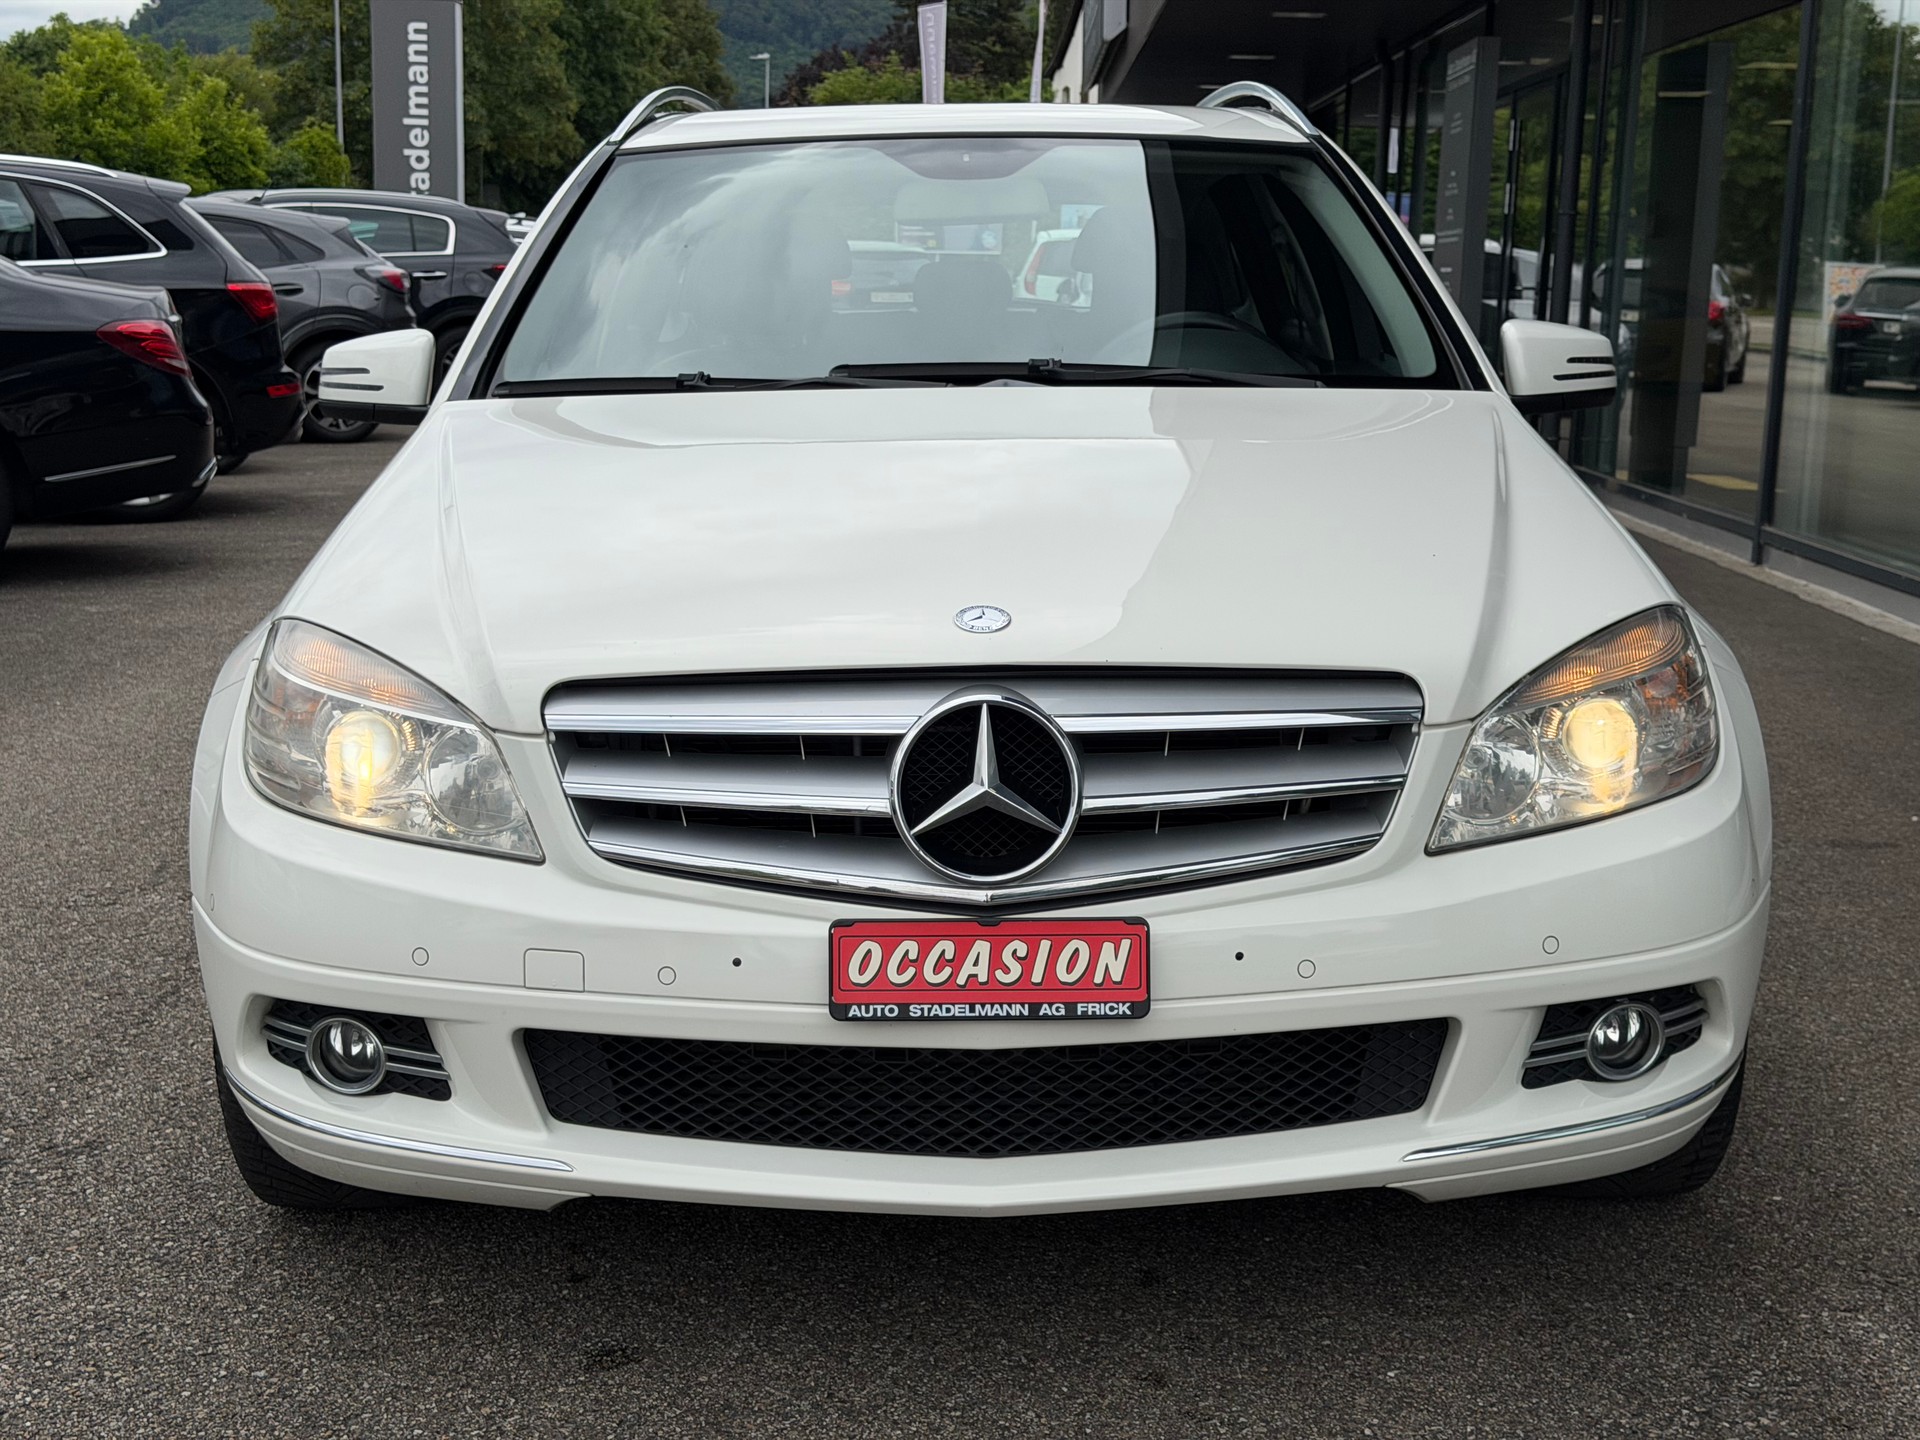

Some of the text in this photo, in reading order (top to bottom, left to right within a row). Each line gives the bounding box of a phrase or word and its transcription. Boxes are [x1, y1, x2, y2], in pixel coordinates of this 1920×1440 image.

[848, 938, 1132, 987] OCCASION
[847, 1002, 1132, 1018] AUTO STADELMANN AG FRICK
